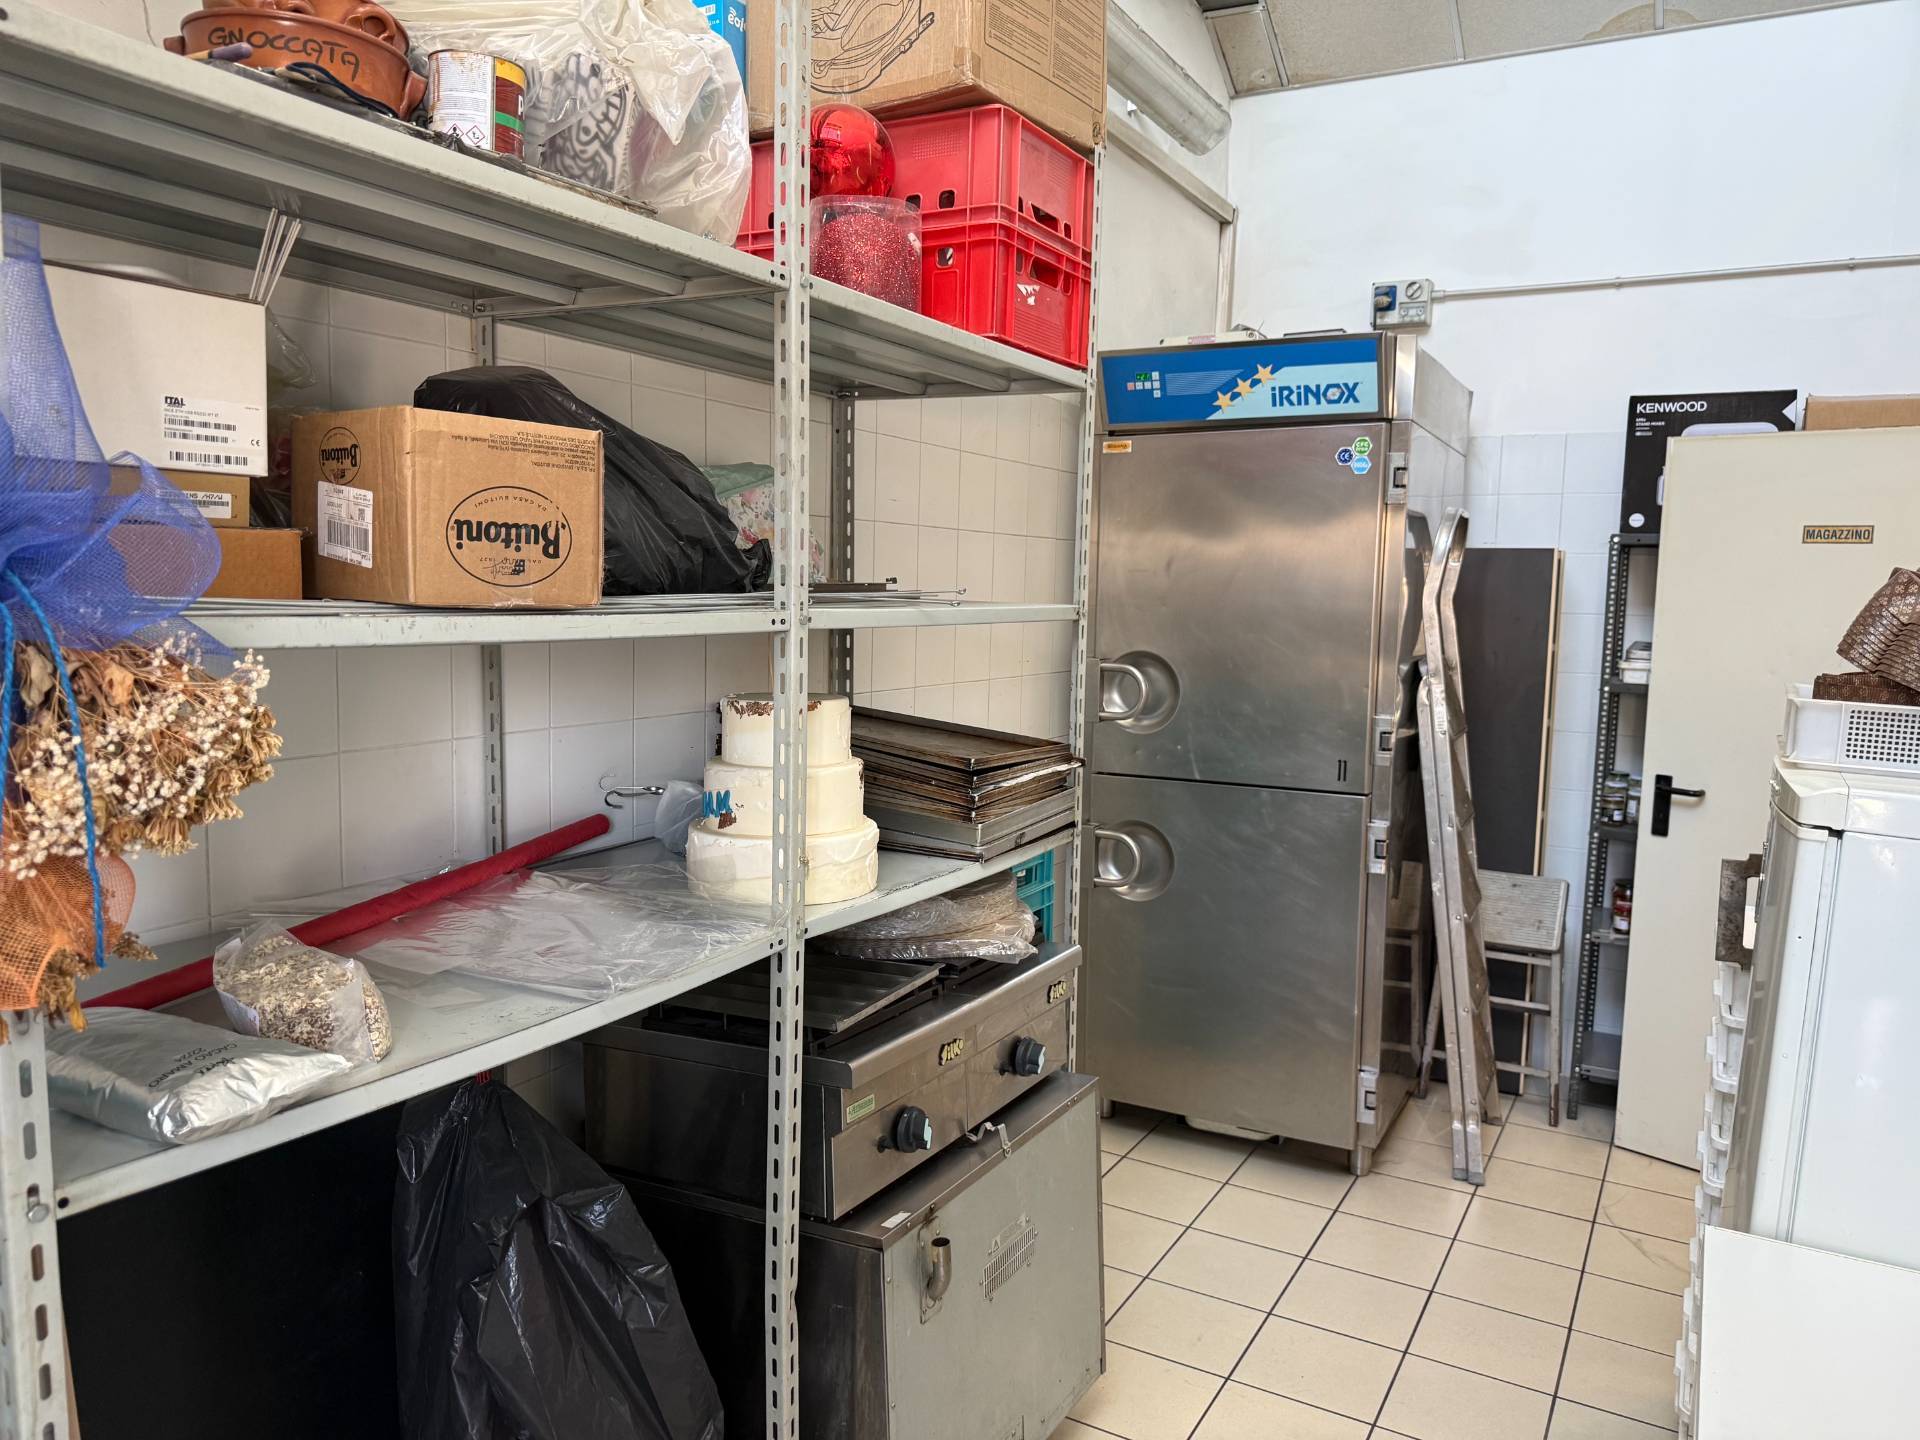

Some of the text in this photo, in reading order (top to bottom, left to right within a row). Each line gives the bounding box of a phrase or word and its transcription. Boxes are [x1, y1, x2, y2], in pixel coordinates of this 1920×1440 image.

[208, 26, 360, 82] GNOCCATA
[164, 396, 186, 406] ITAL
[1636, 401, 1708, 414] KENWOOD
[321, 444, 359, 467] Buitoni
[454, 519, 566, 560] Buitoni
[1805, 529, 1871, 541] MAGAZZINO
